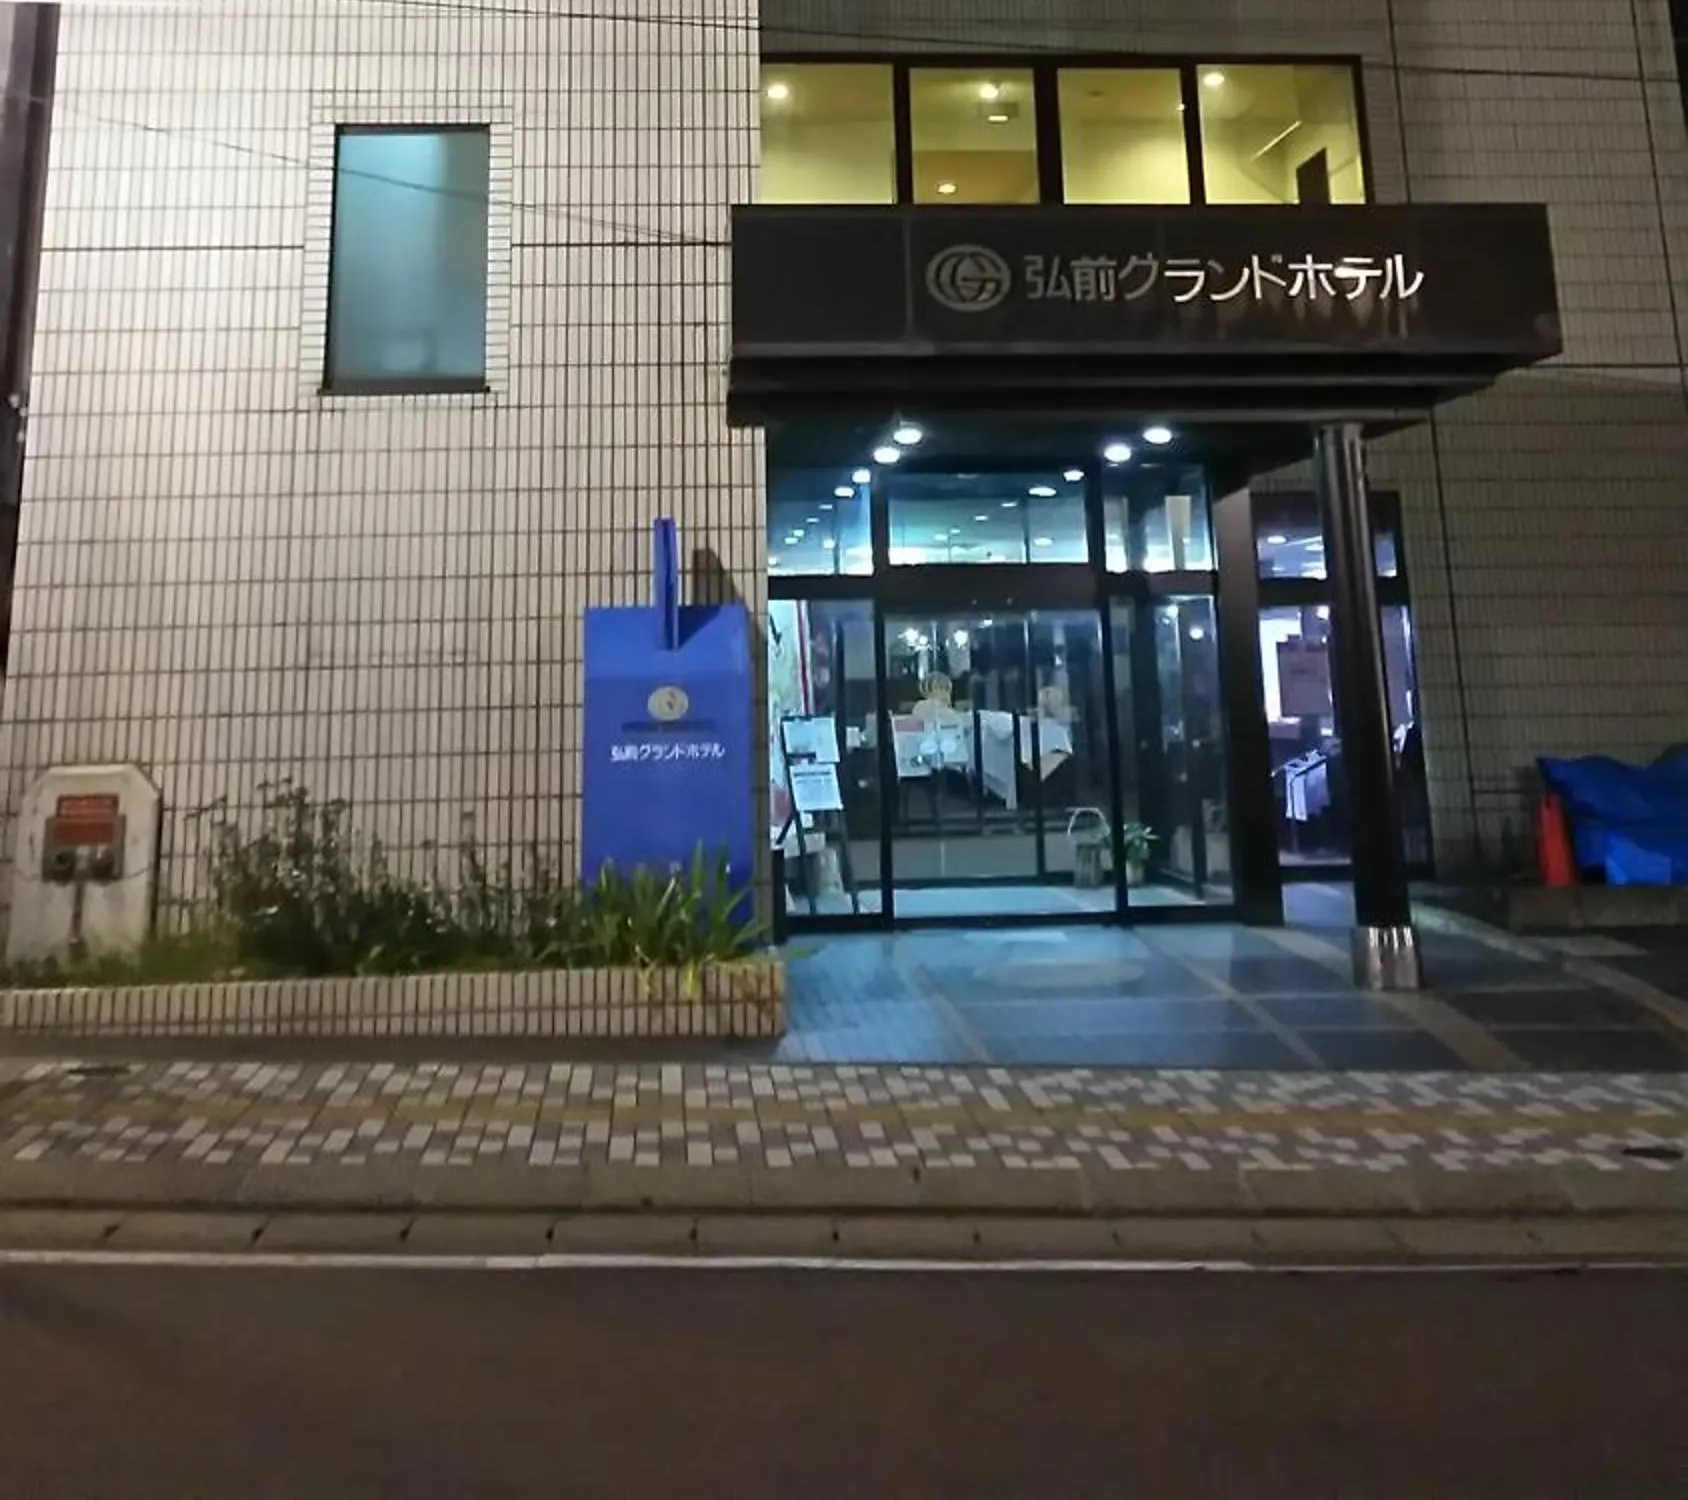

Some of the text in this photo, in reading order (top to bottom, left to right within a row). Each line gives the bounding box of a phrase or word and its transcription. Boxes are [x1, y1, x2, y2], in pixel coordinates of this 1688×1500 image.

[1023, 252, 1425, 303] 弘前グランドホテル
